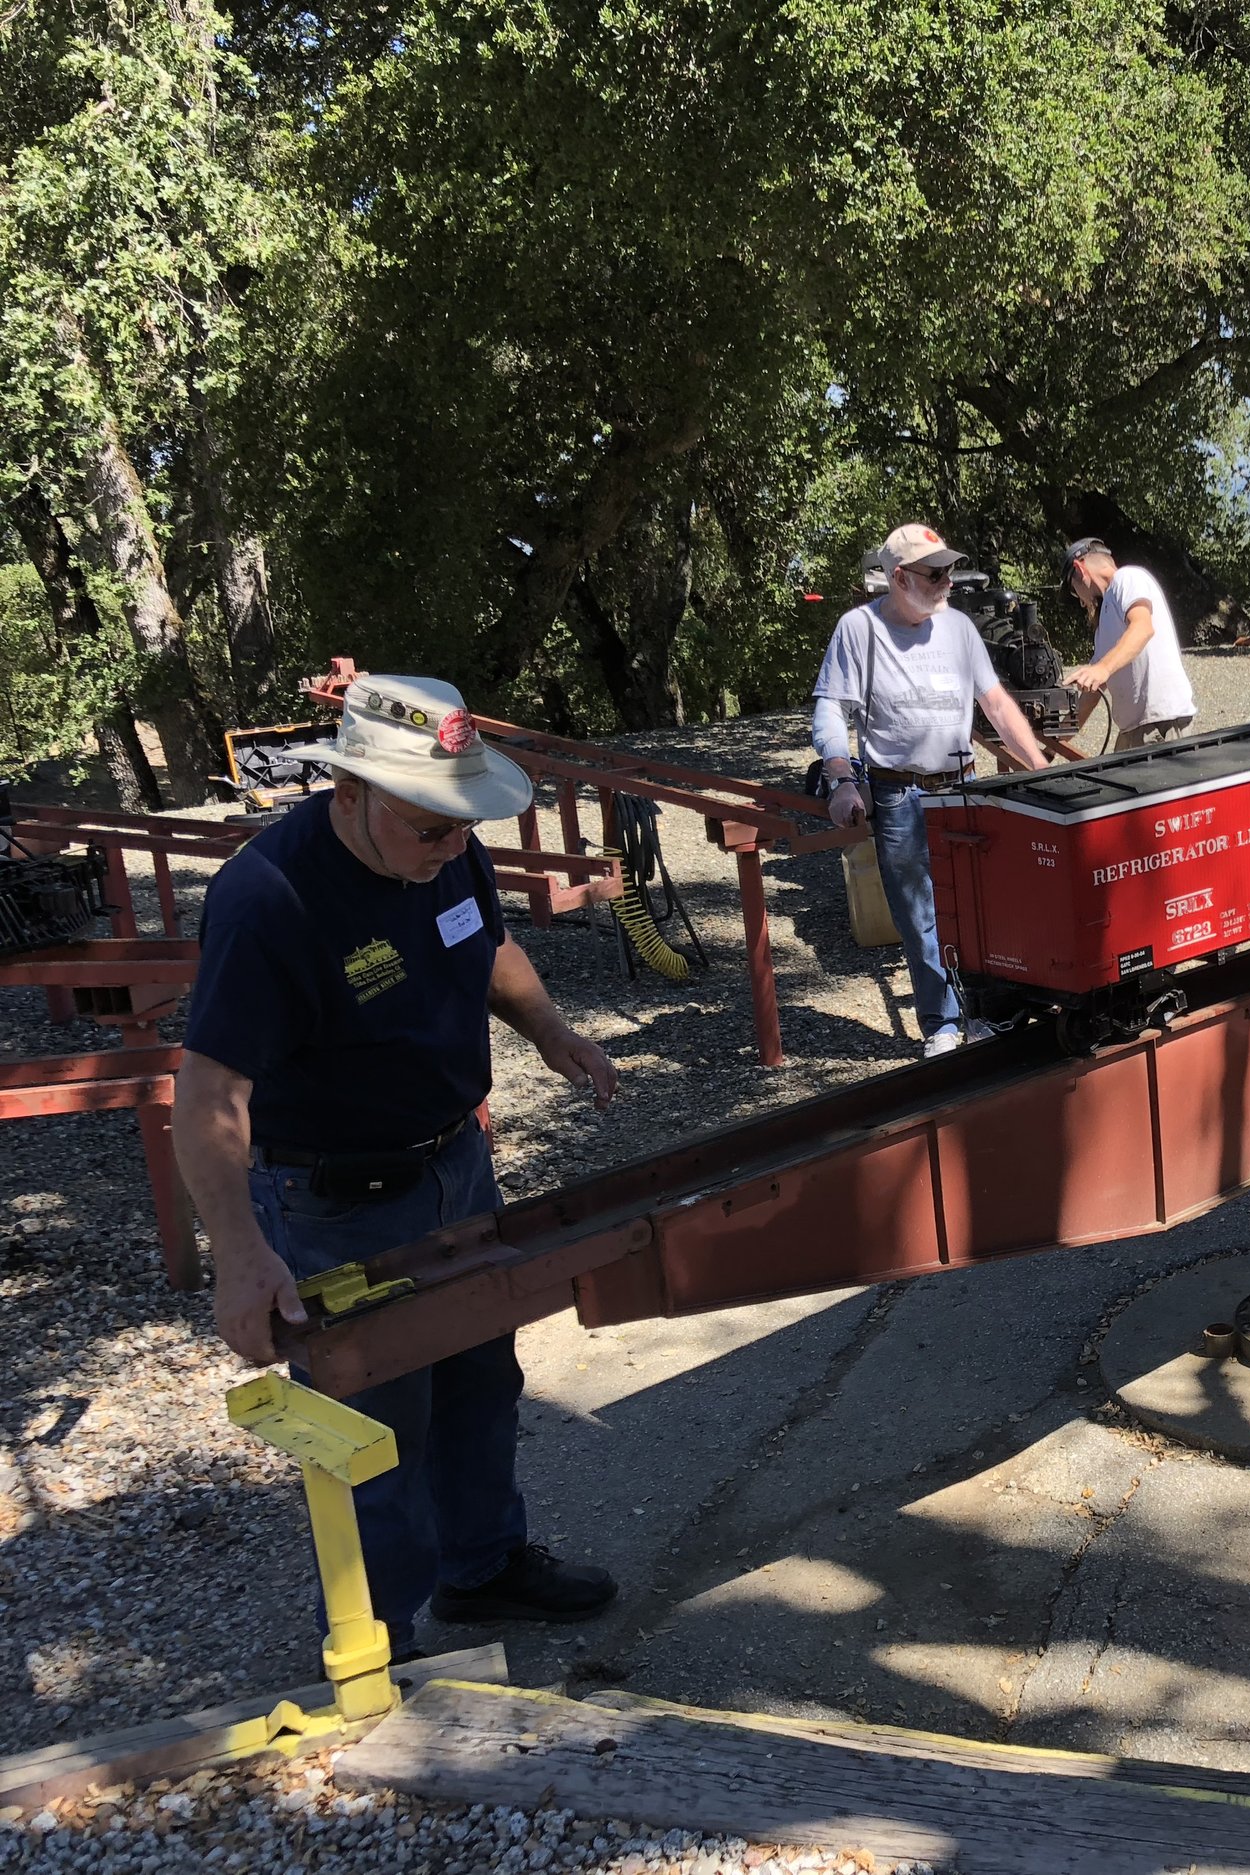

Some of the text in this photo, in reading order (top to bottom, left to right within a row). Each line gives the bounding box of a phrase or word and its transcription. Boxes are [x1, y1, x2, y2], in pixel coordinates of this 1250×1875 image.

[1154, 807, 1216, 838] SWIFT
[1037, 857, 1055, 868] 6723
[1092, 835, 1229, 886] REFRIGERATOR
[1172, 921, 1212, 943] 6723
